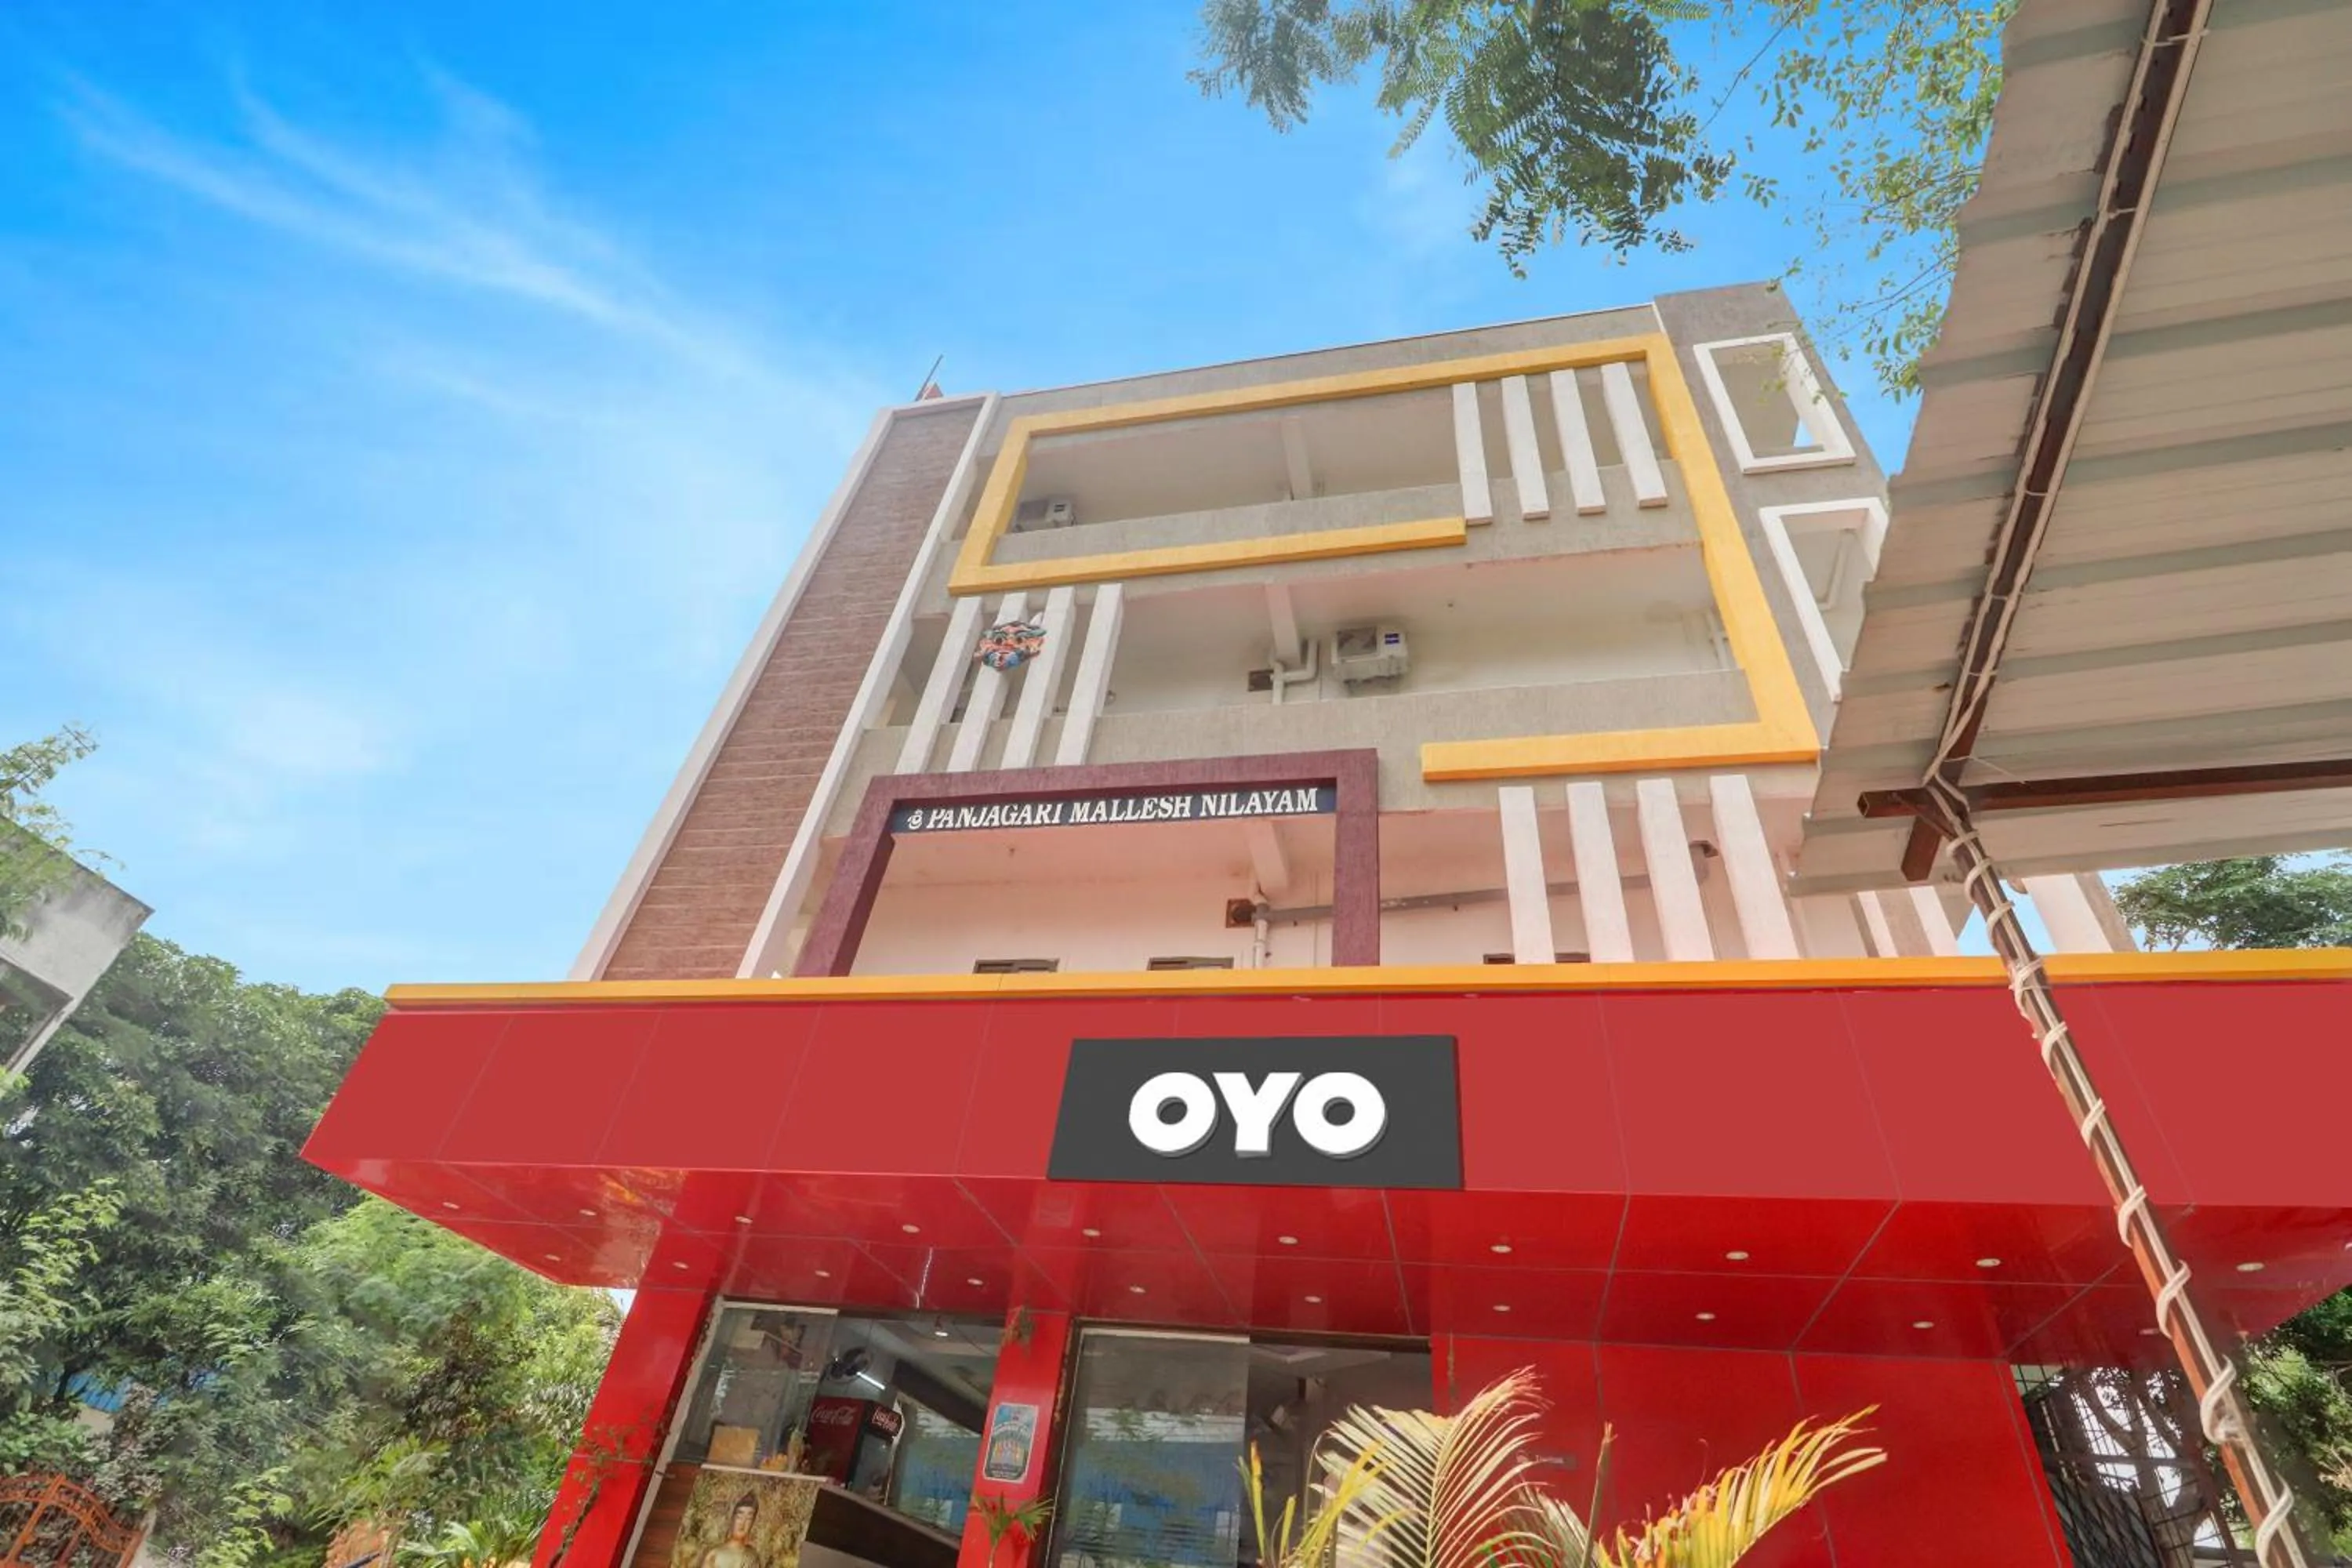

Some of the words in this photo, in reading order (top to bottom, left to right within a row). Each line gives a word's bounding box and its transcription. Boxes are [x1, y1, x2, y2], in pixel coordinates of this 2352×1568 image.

[926, 803, 1064, 829] PANJAGARI
[1069, 795, 1193, 823] MALLESH
[1199, 787, 1319, 816] NILAYAM
[1129, 1071, 1387, 1159] OYO
